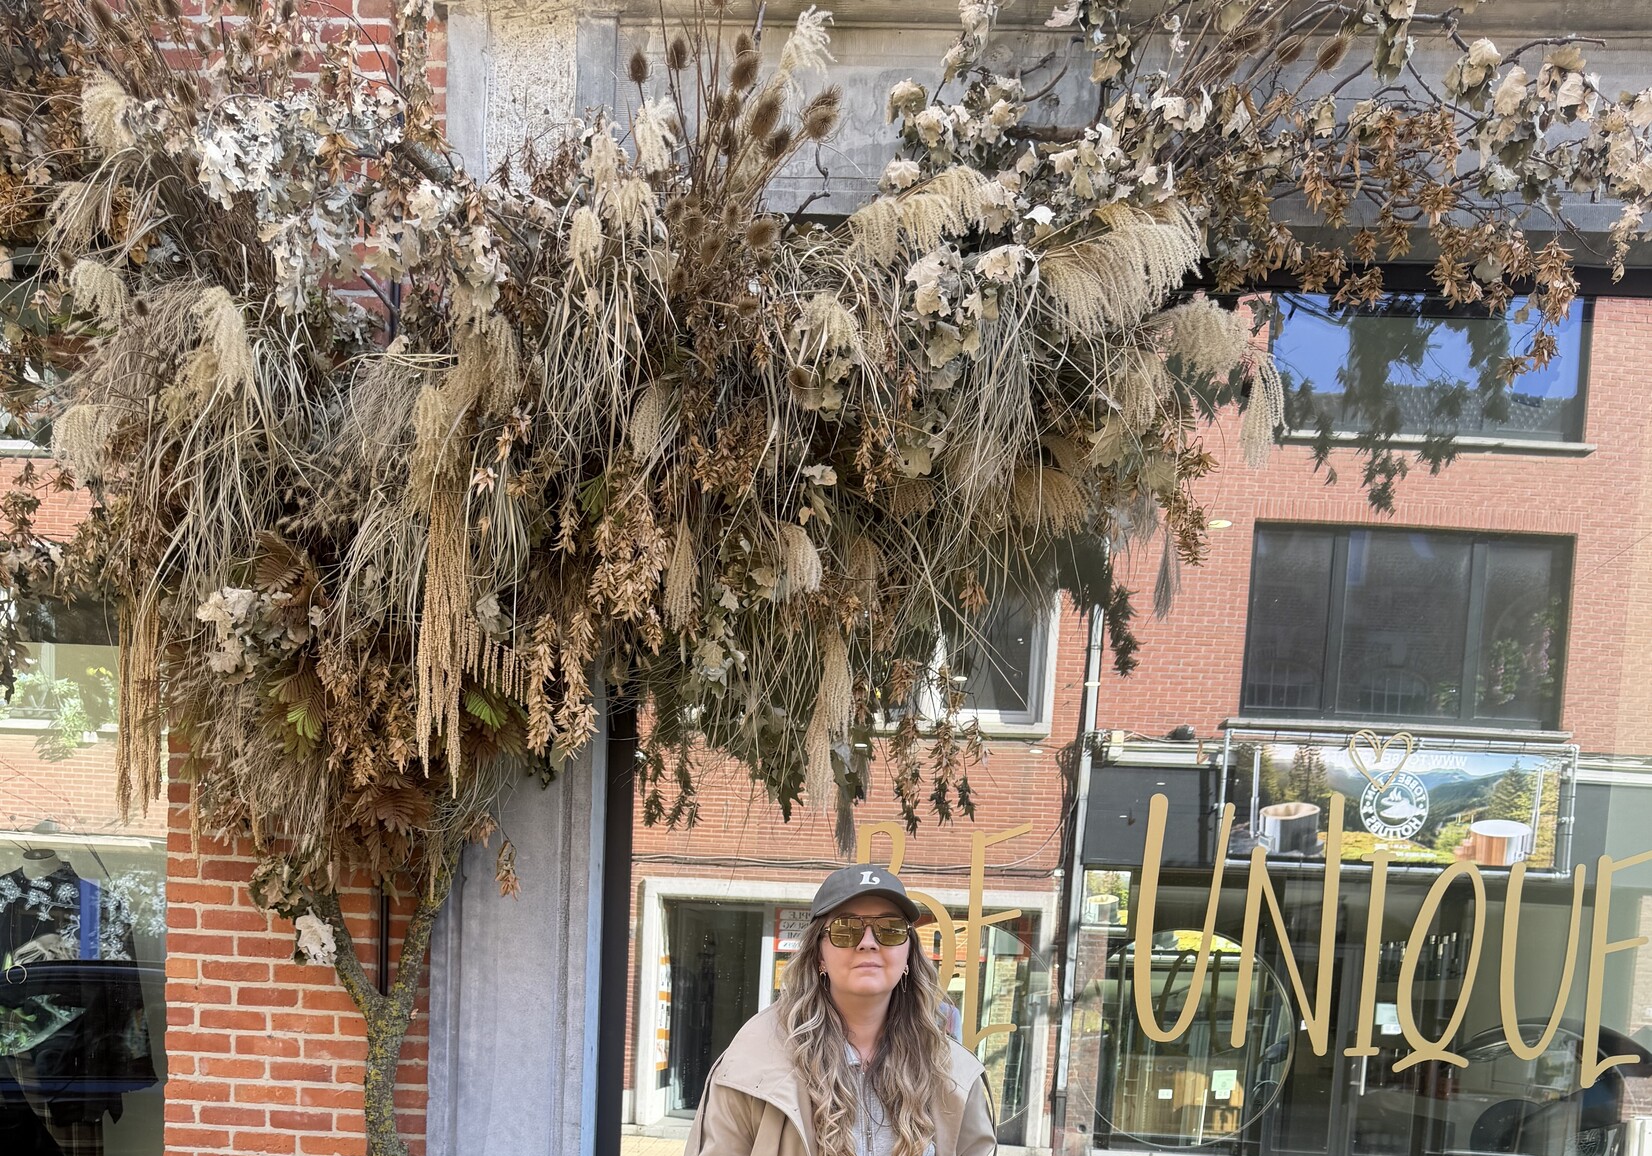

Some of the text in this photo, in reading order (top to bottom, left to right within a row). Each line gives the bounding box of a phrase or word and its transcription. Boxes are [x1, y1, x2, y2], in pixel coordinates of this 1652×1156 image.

[857, 793, 1652, 1089] BE UNIQUE
[860, 871, 880, 885] L
